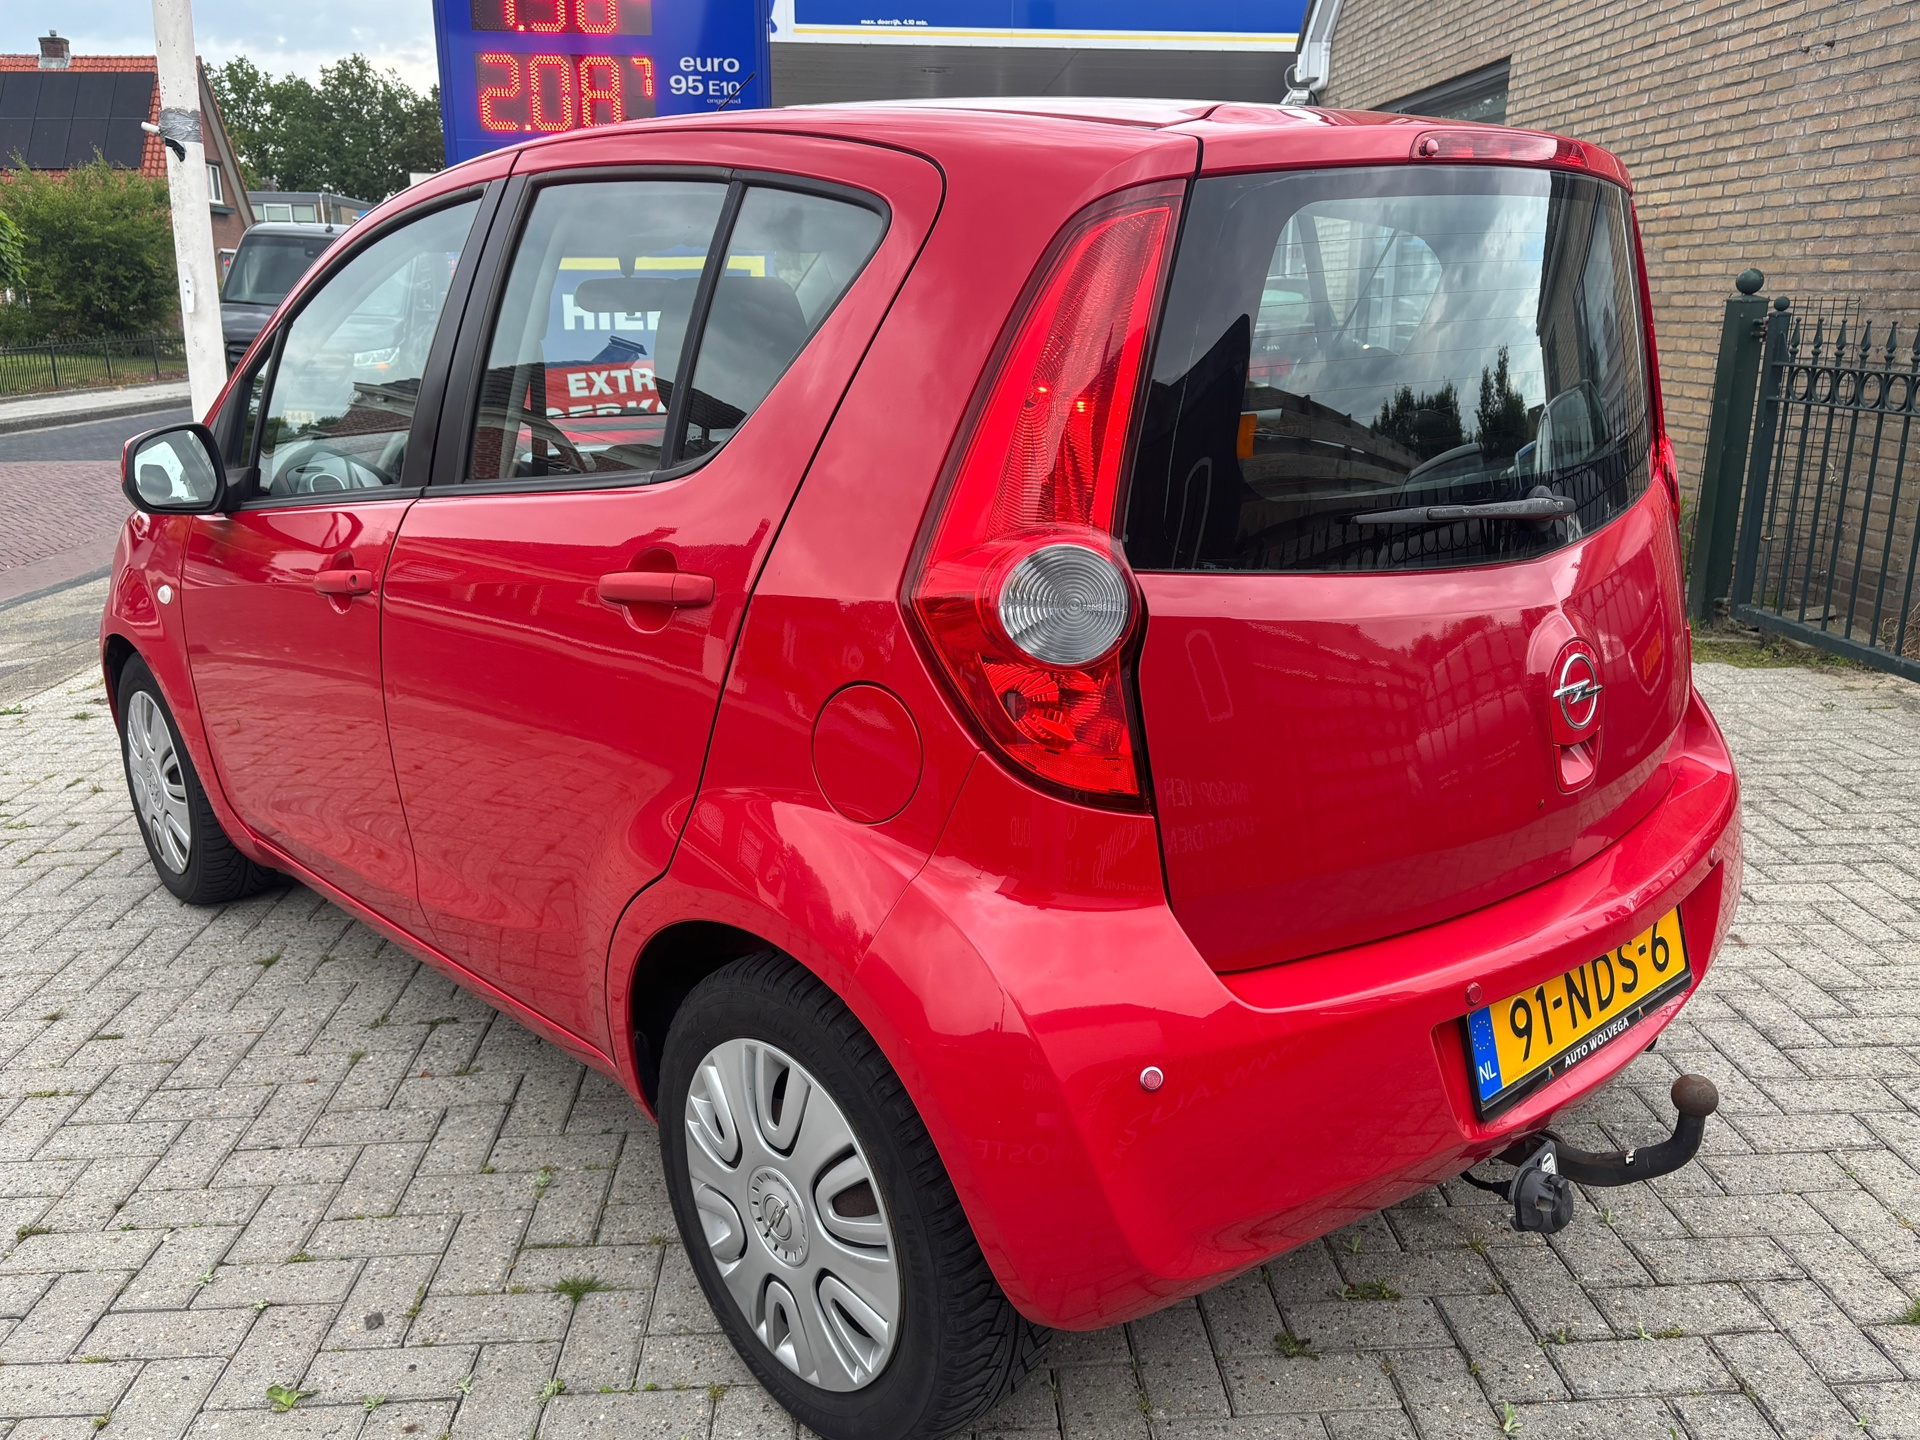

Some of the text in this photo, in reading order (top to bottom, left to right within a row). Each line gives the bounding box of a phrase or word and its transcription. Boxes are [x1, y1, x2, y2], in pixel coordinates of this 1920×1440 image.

[679, 56, 740, 73] euro
[669, 75, 741, 96] 95 E10
[1509, 921, 1670, 1063] 91-NDS-6
[1564, 1017, 1630, 1069] AUTO WOLVEGA
[1478, 1060, 1497, 1084] NL
